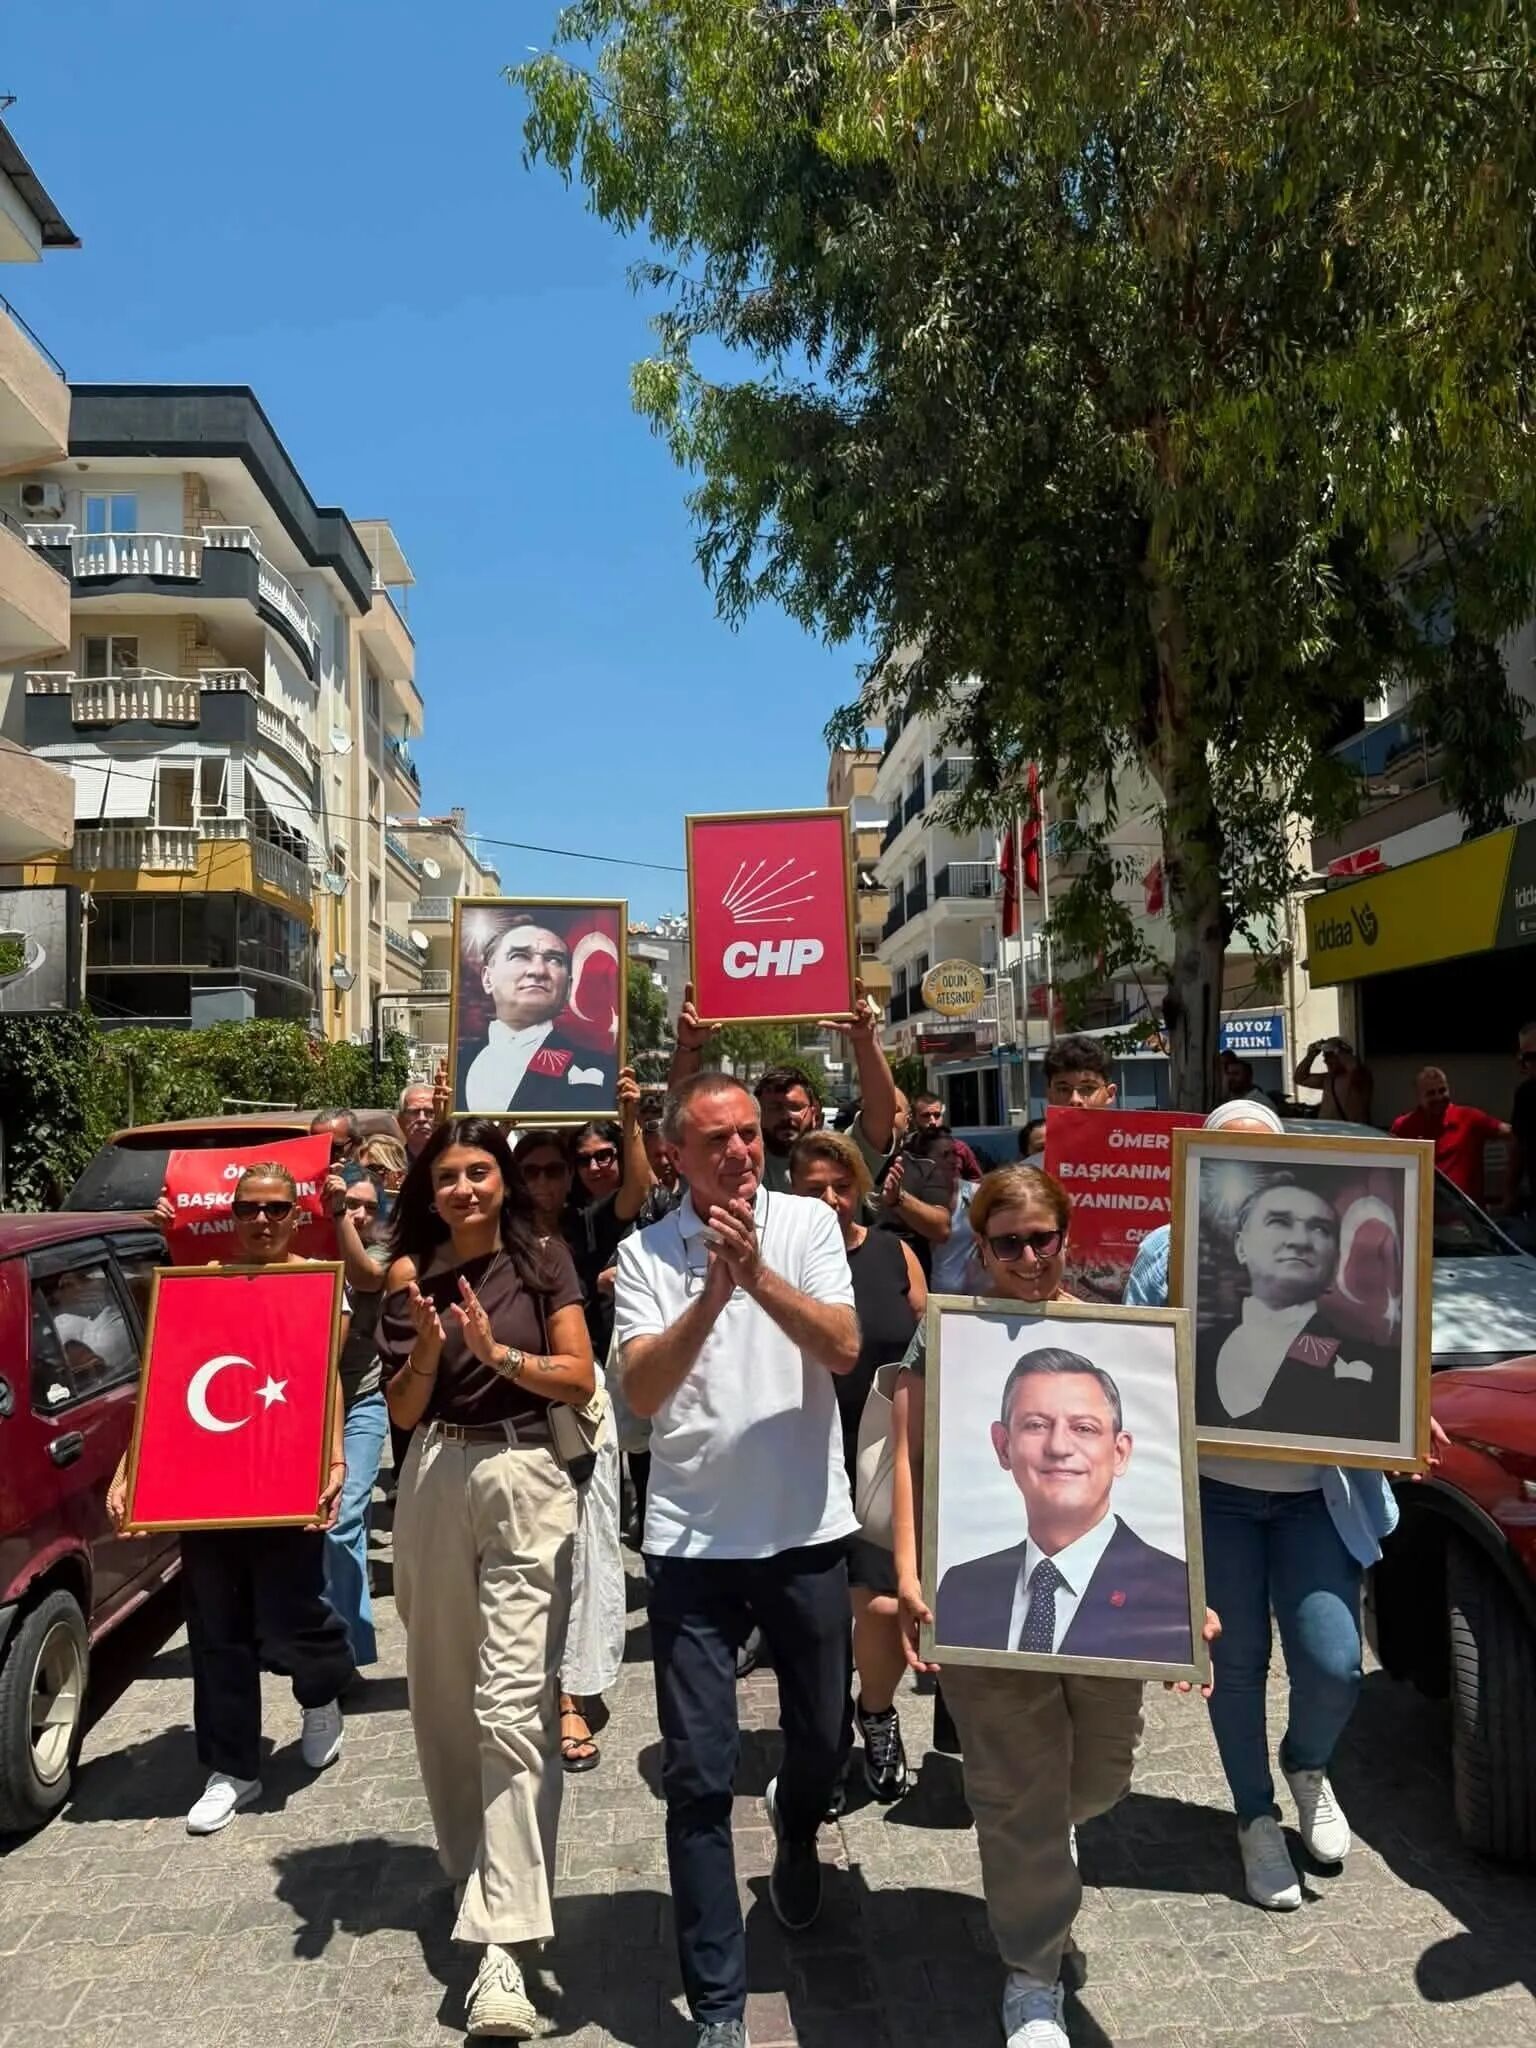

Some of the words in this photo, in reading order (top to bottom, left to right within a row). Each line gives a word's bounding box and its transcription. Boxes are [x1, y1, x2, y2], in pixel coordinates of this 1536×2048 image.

[1515, 884, 1536, 910] idd
[1314, 916, 1353, 952] iddaa
[722, 938, 825, 979] CHP
[942, 975, 968, 988] ODUN
[1225, 1021, 1273, 1033] BOYOZ
[1108, 1129, 1170, 1149] ÖMER
[1059, 1162, 1171, 1182] BAŞKANIM
[1125, 1228, 1153, 1242] CH
